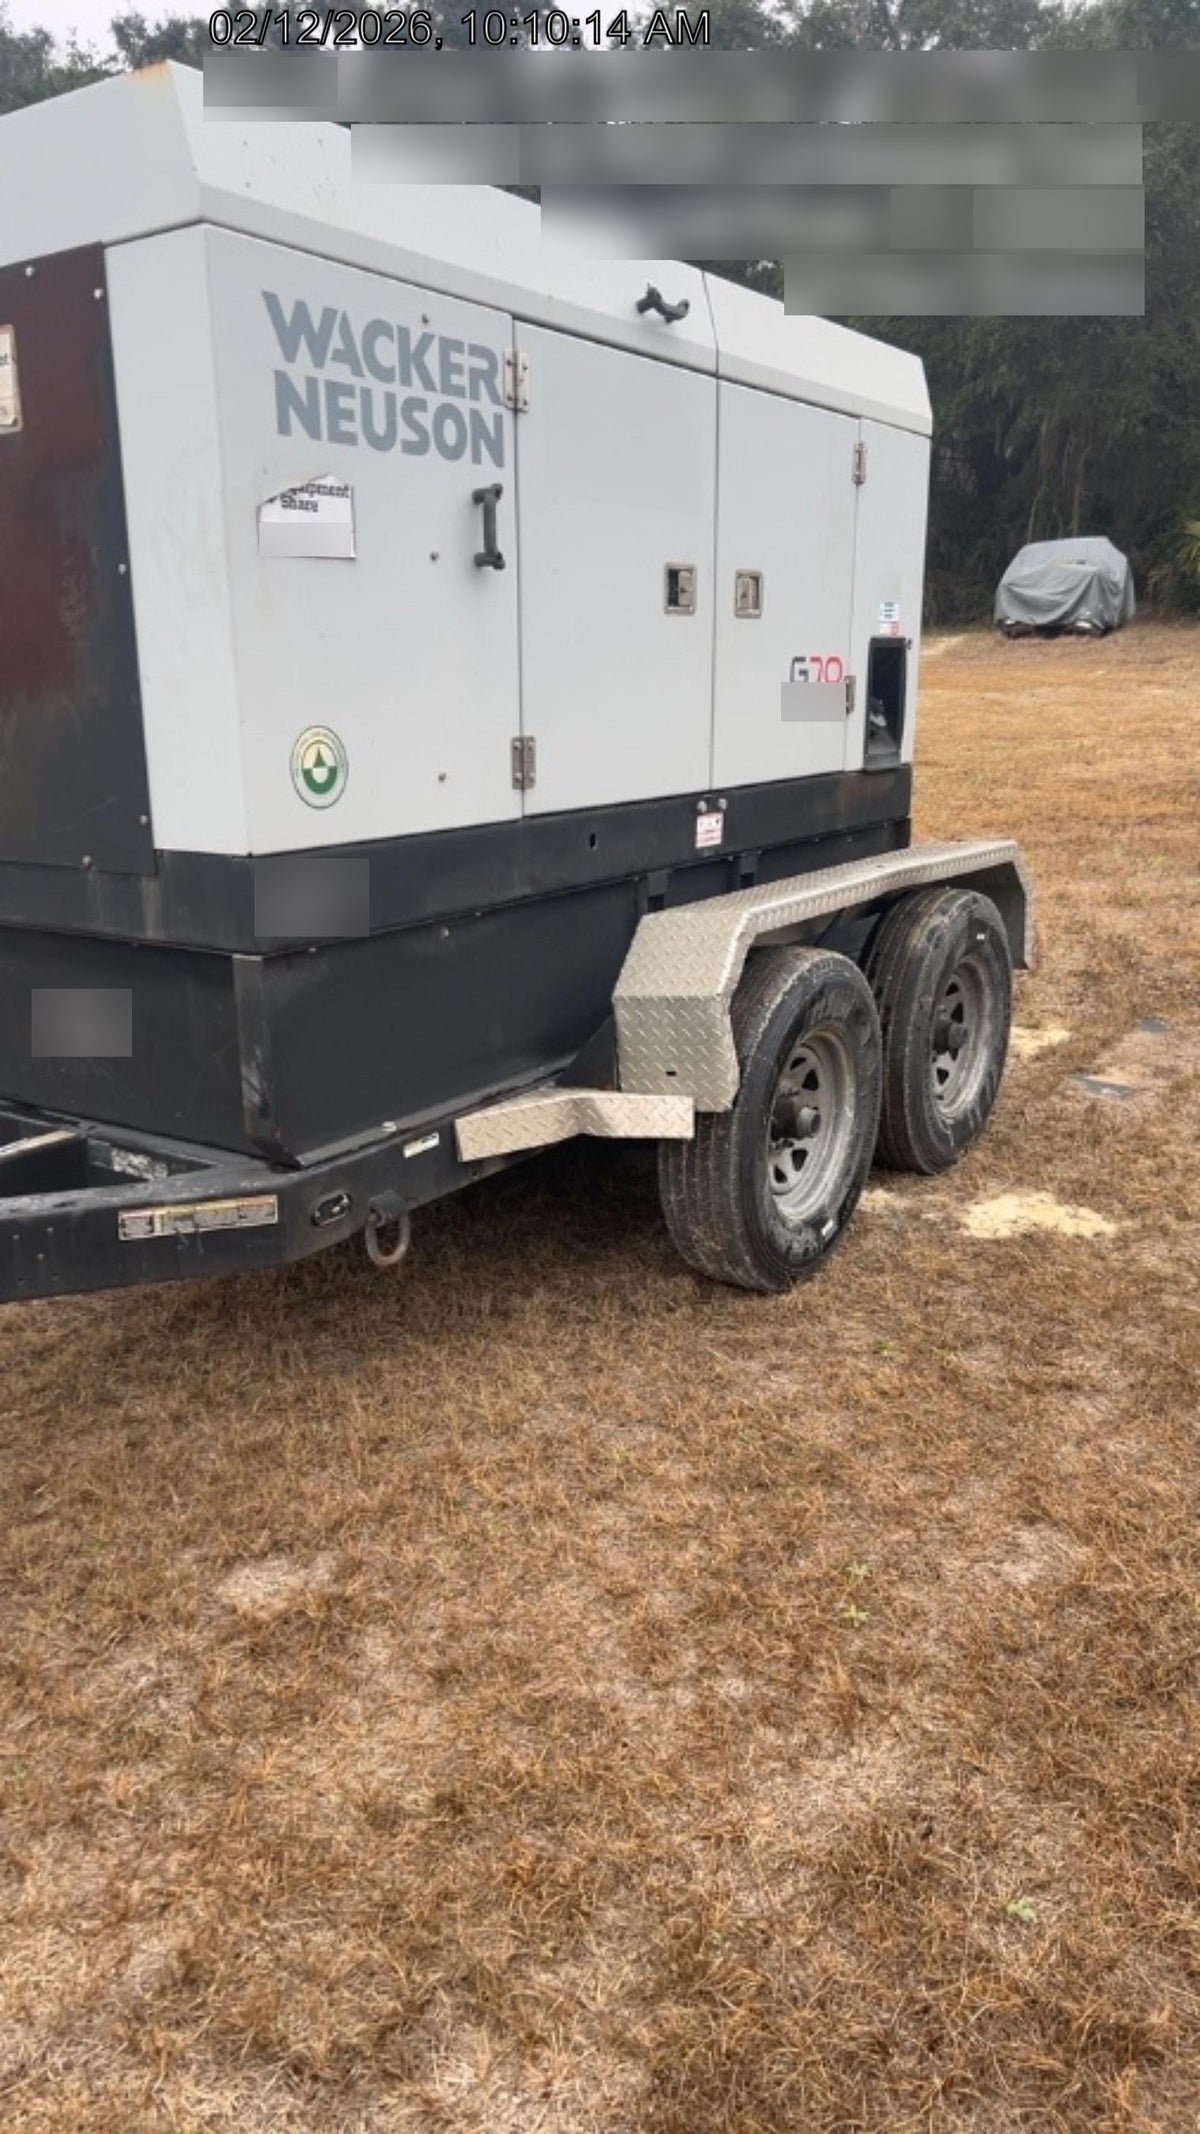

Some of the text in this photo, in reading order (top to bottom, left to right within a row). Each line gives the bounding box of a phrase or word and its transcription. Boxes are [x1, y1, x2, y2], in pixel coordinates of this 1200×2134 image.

[261, 289, 505, 407] WACKER
[274, 368, 505, 469] NEUSON
[789, 655, 843, 683] G70
